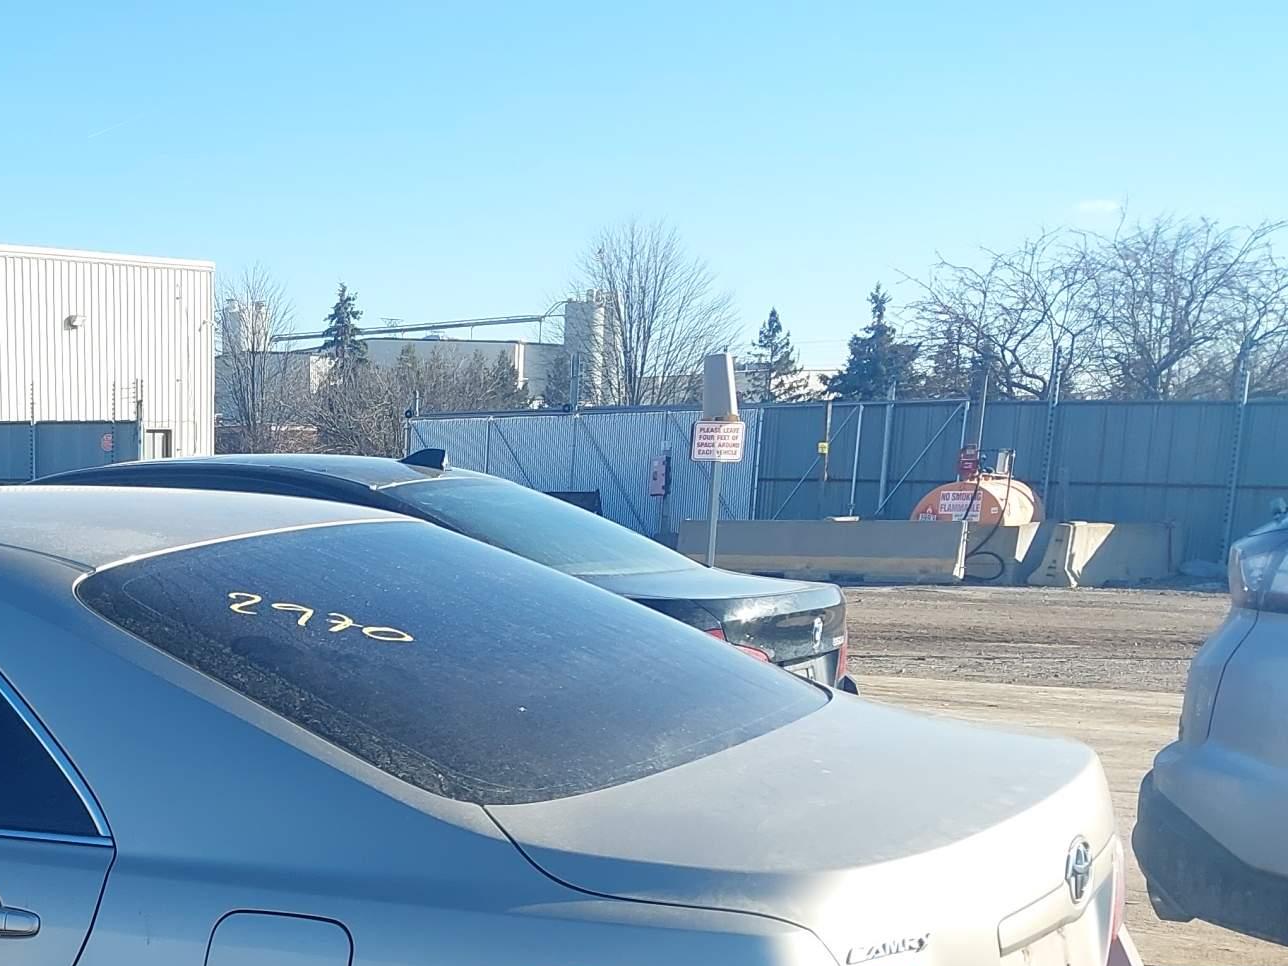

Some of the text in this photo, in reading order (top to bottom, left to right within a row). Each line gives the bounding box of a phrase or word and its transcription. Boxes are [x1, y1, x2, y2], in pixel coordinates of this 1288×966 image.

[941, 492, 951, 501] NO
[227, 591, 415, 642] 2970
[845, 932, 931, 966] CAMRY
